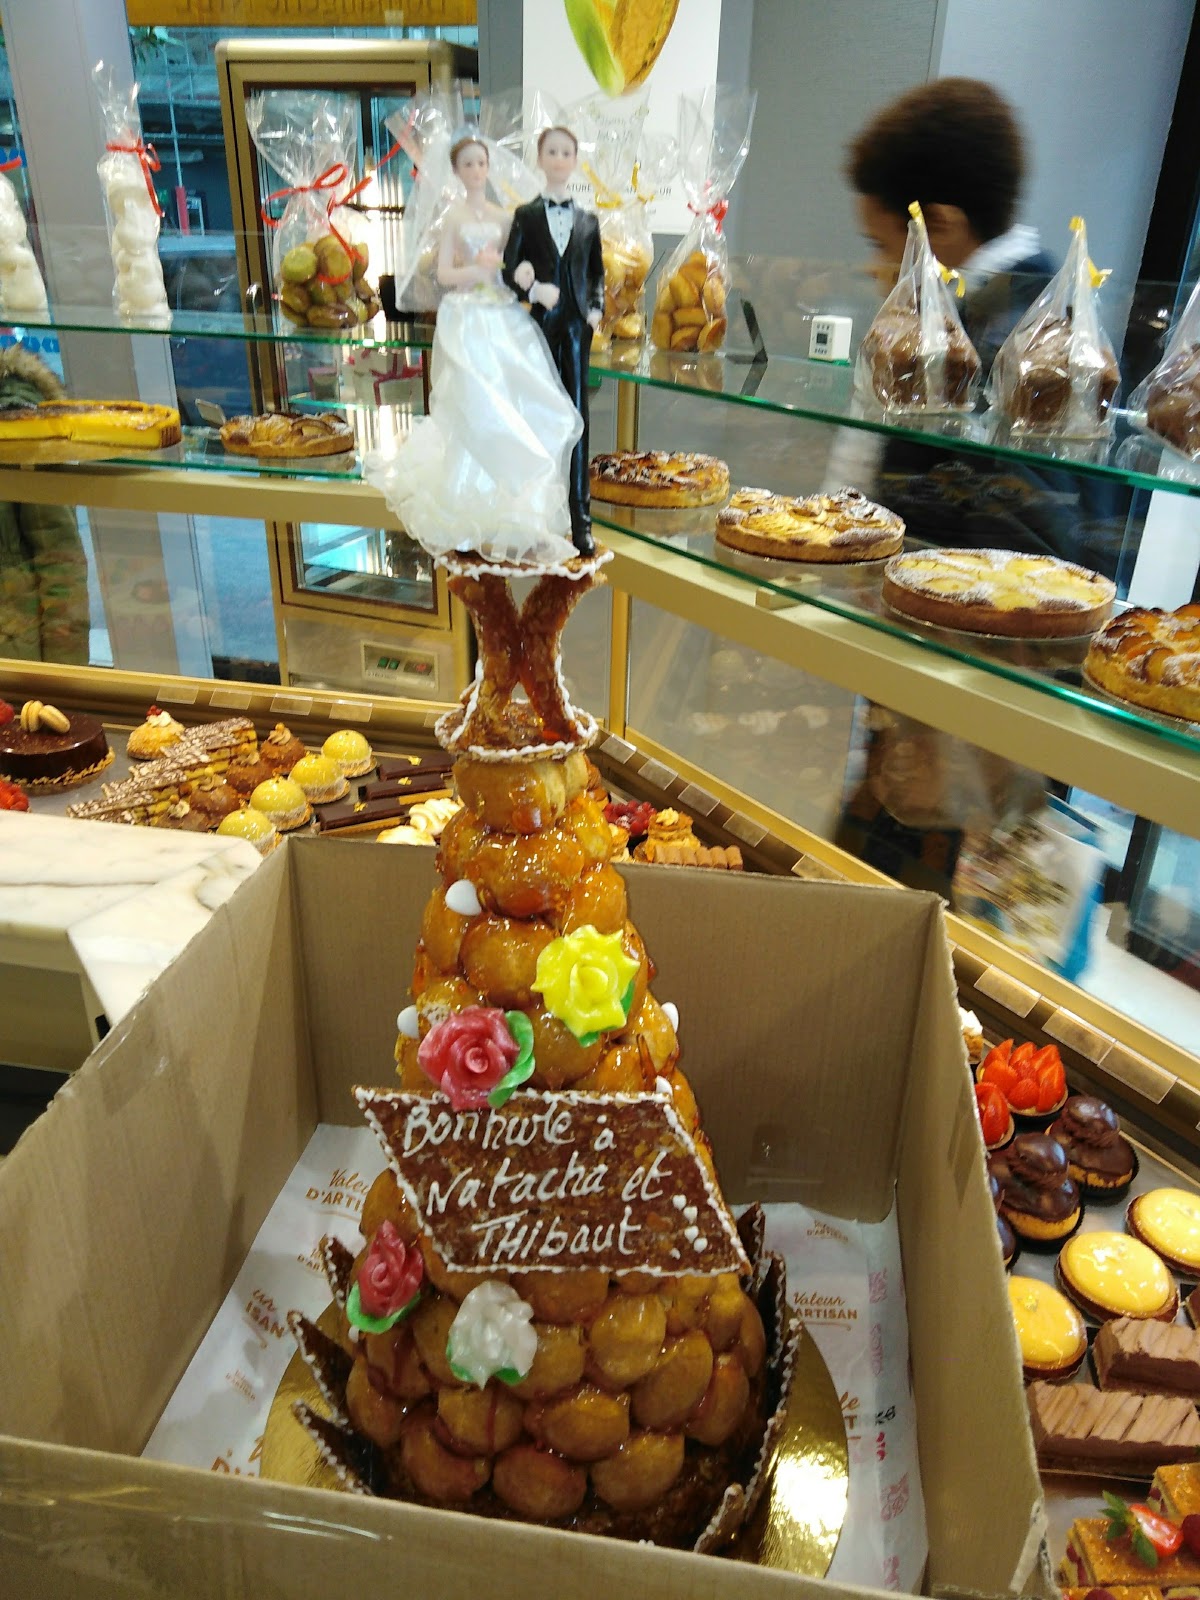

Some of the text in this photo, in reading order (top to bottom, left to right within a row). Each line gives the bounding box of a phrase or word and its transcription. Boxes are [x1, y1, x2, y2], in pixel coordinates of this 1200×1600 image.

[426, 1150, 672, 1216] Natacha et
[305, 1187, 363, 1213] D'ARTI
[793, 1291, 846, 1307] Valeur
[794, 1308, 857, 1320] ARTISAN
